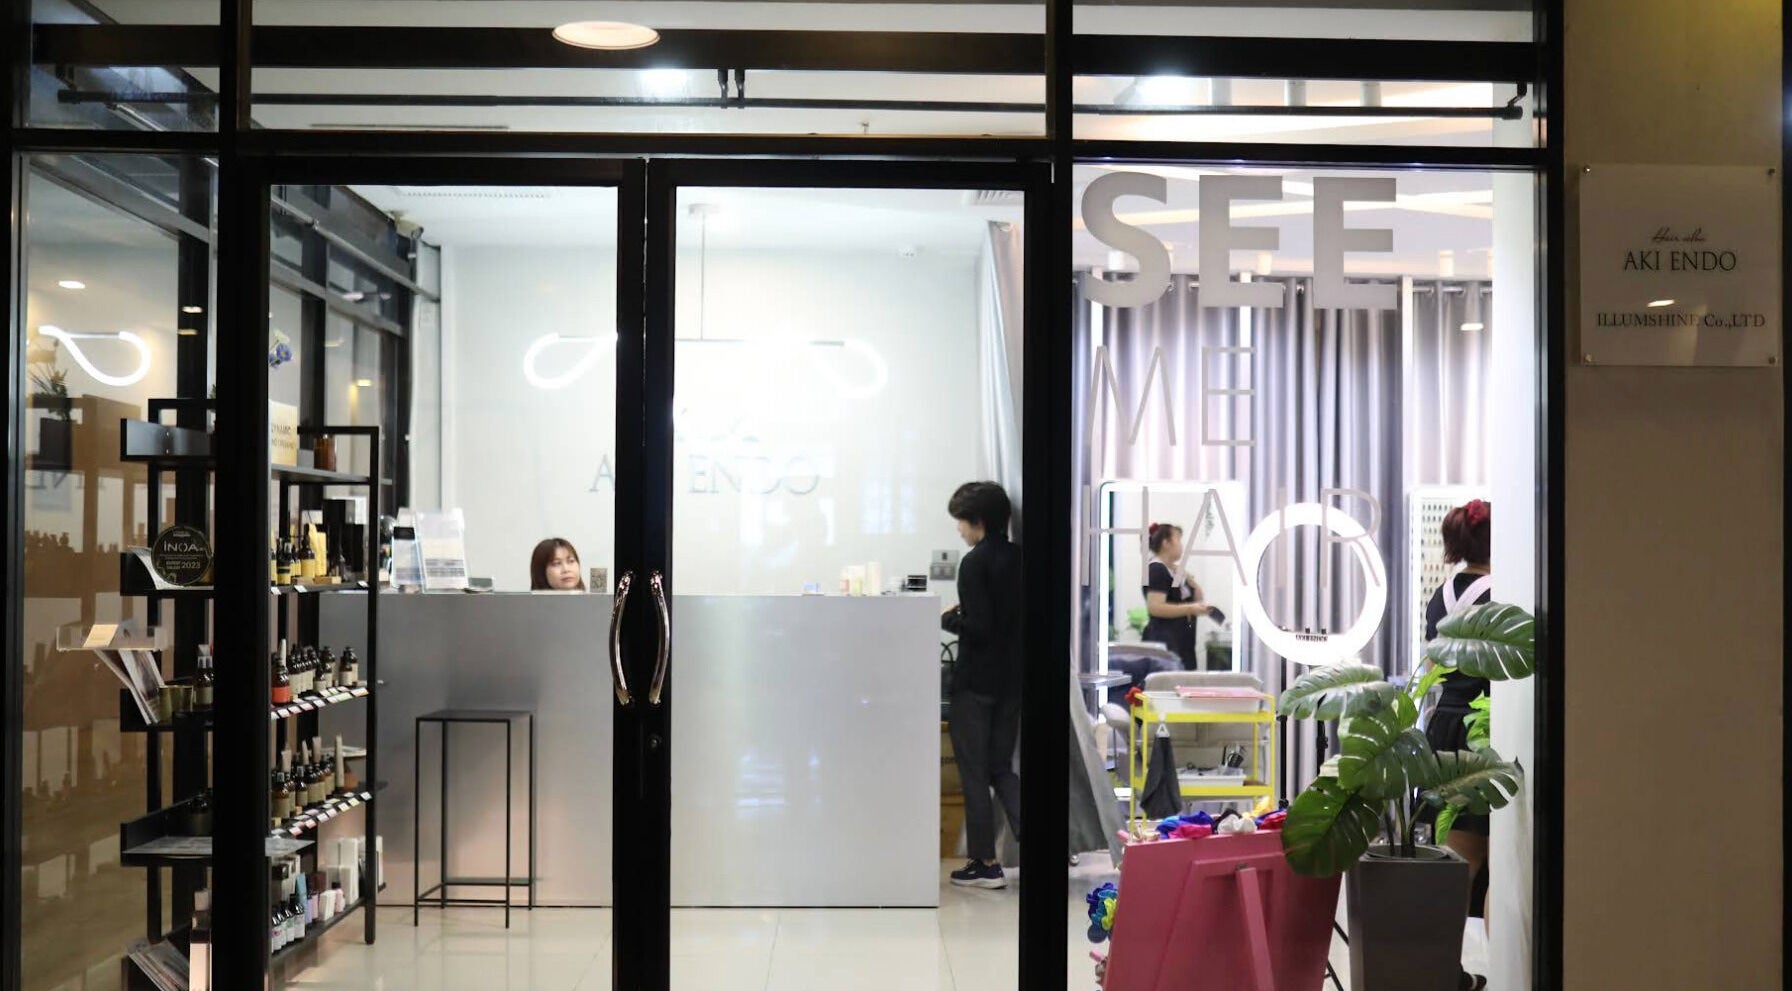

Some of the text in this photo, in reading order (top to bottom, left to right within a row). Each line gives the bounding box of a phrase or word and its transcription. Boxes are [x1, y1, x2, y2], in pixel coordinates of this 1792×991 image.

[1081, 172, 1398, 310] SEE
[1624, 251, 1737, 271] AKI ENDO
[1597, 312, 1699, 328] ILLUMSHINE
[1088, 346, 1257, 448] ME
[1081, 484, 1383, 589] HAIR
